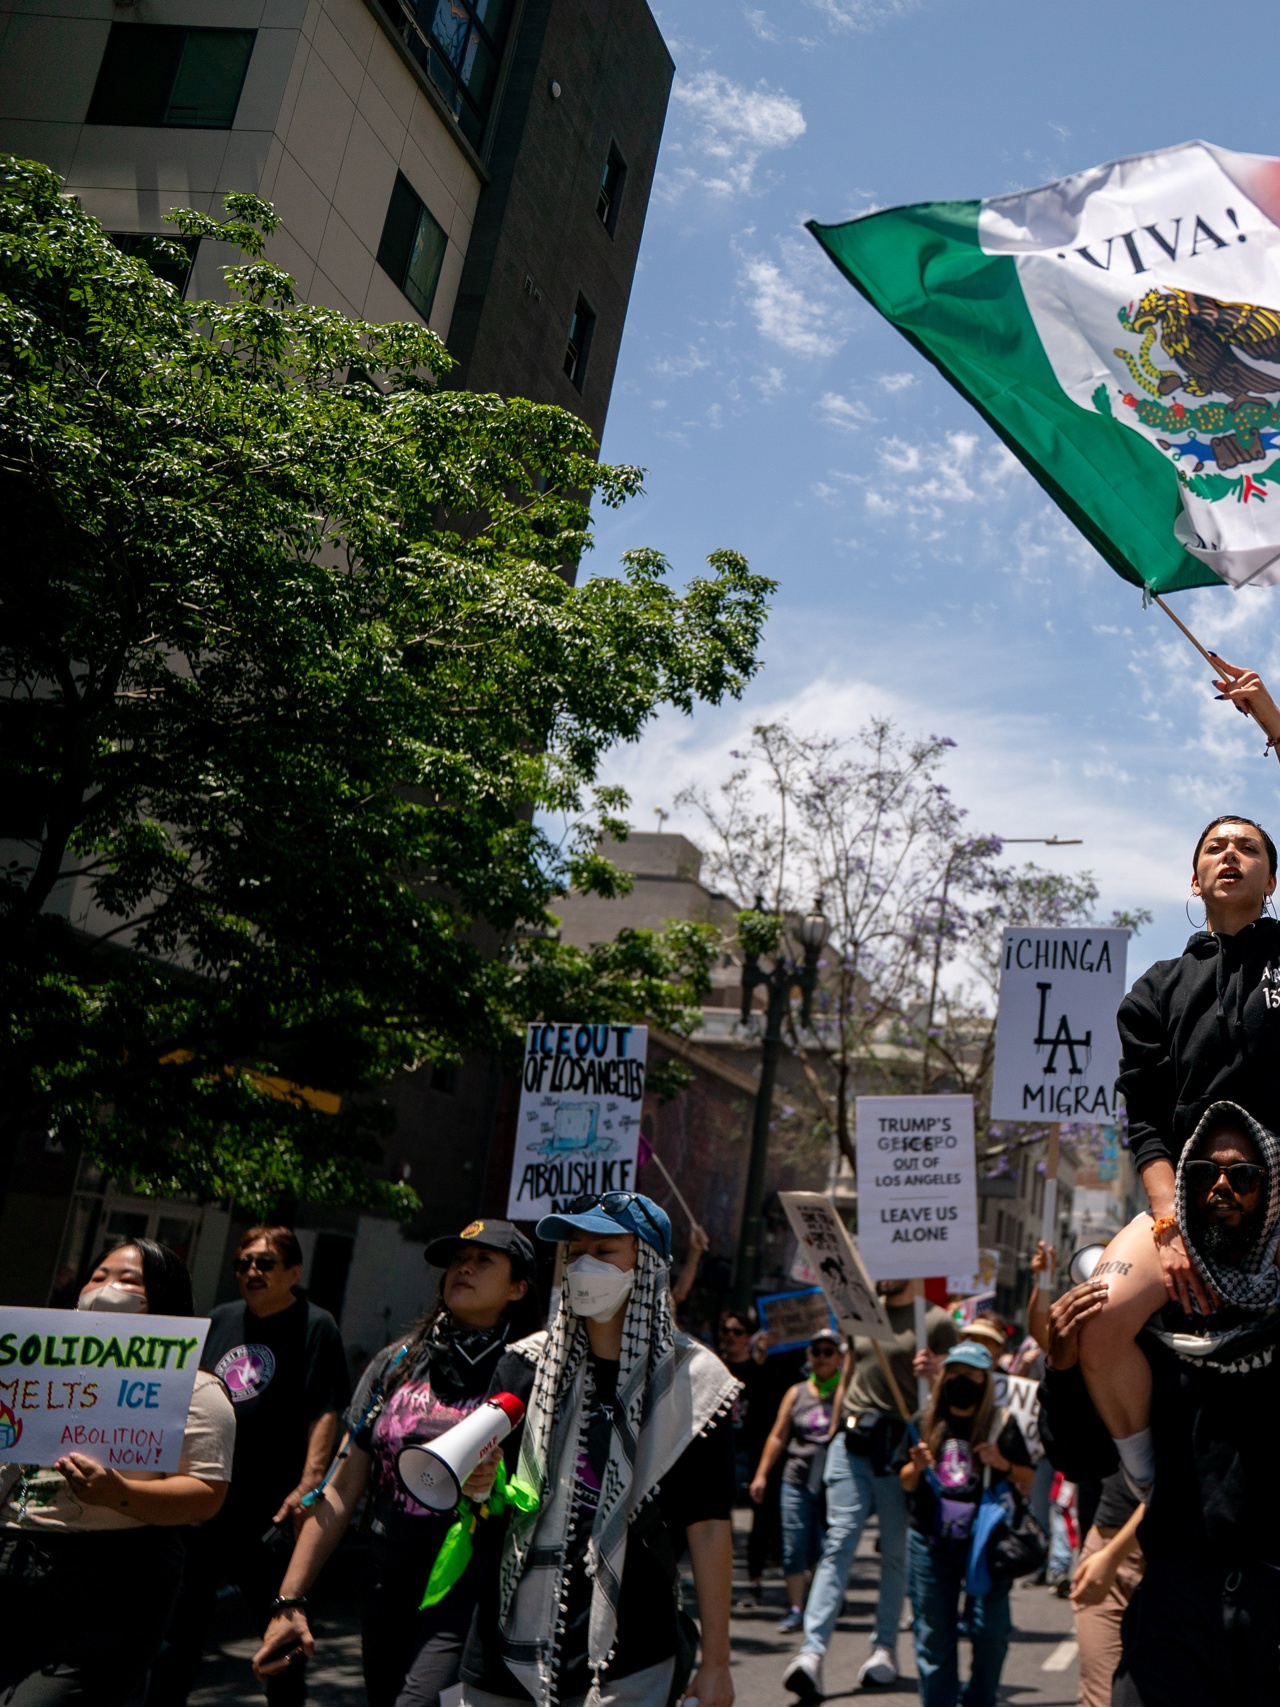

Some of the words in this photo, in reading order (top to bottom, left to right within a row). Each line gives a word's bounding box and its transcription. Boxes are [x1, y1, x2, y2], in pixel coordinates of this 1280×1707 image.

[1057, 207, 1247, 275] VIVA!
[528, 1025, 572, 1056] ICE
[575, 1024, 633, 1058] OUT
[1034, 982, 1092, 1075] LA
[524, 1055, 552, 1093] OF
[551, 1055, 586, 1093] LOS
[583, 1057, 645, 1101] ANGELES
[1022, 1083, 1118, 1119] MIGRA!
[878, 1117, 952, 1133] TRUMP'S
[517, 1160, 597, 1201] ABOLISH
[600, 1159, 633, 1194] ICE
[893, 1158, 919, 1171] OUT
[922, 1157, 940, 1169] OF
[875, 1175, 901, 1188] LOS
[904, 1173, 962, 1187] ANGELES
[880, 1207, 932, 1223] LEAVE
[936, 1206, 958, 1221] US
[892, 1226, 949, 1244] ALONE
[0, 1333, 199, 1370] SOLIDARITY
[0, 1378, 98, 1410] MELTS
[117, 1379, 162, 1409] ICE
[60, 1425, 164, 1447] ABOLITION
[108, 1448, 163, 1465] NOW!
